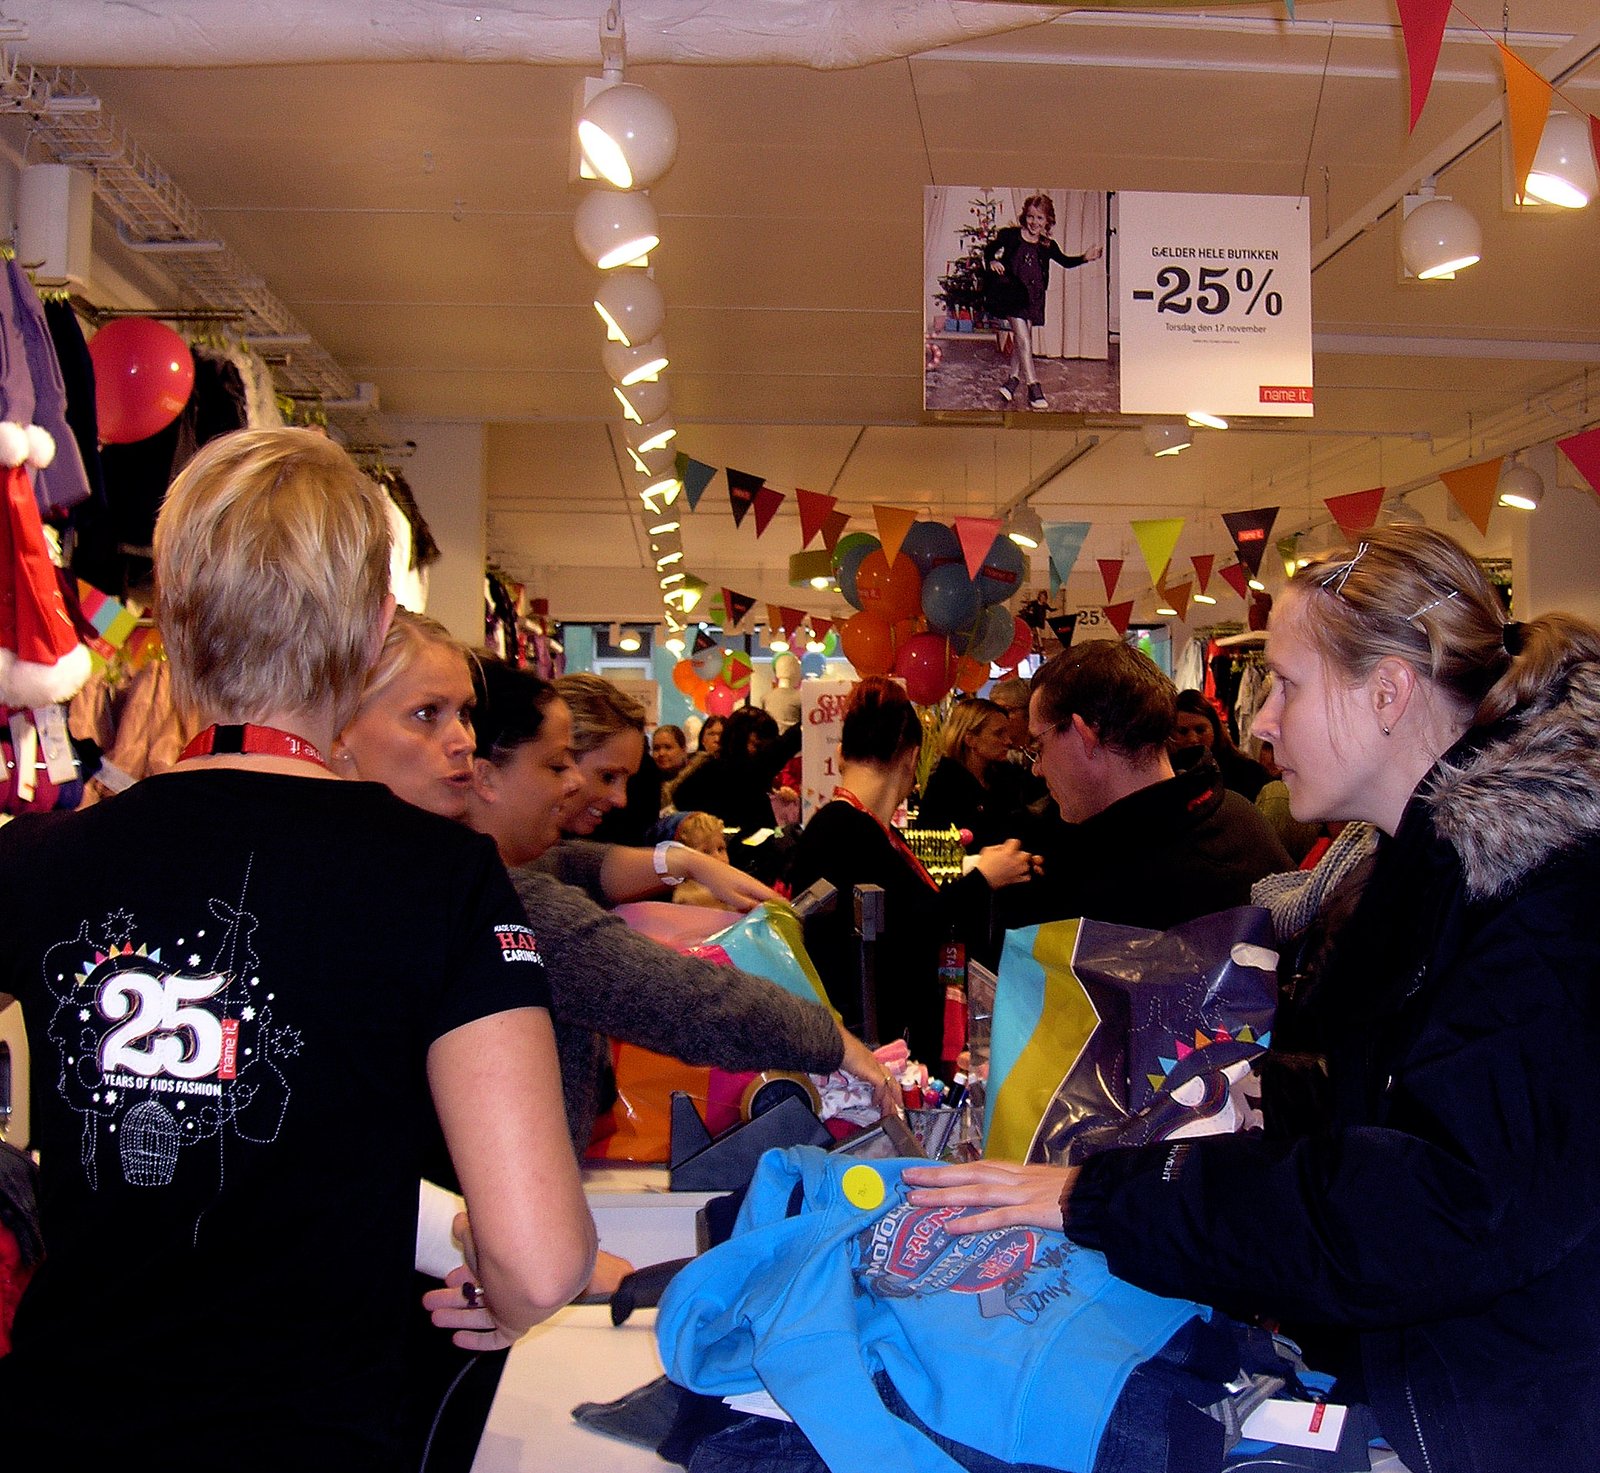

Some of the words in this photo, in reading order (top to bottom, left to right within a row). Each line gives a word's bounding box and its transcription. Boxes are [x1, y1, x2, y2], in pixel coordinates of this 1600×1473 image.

[1152, 247, 1196, 259] GÆLDER
[1198, 248, 1225, 259] HELE
[1228, 249, 1279, 261] BUTIKKEN
[1132, 266, 1283, 317] -25%
[1166, 322, 1197, 334] Torsdag
[1198, 323, 1213, 333] den
[1227, 324, 1267, 334] november
[1263, 389, 1296, 402] name
[502, 950, 537, 963] CARING
[100, 970, 229, 1080] 25
[222, 1038, 236, 1073] name
[103, 1073, 135, 1090] YEARS
[135, 1076, 149, 1090] OF
[150, 1077, 175, 1093] KIDS
[175, 1080, 223, 1097] FASHION
